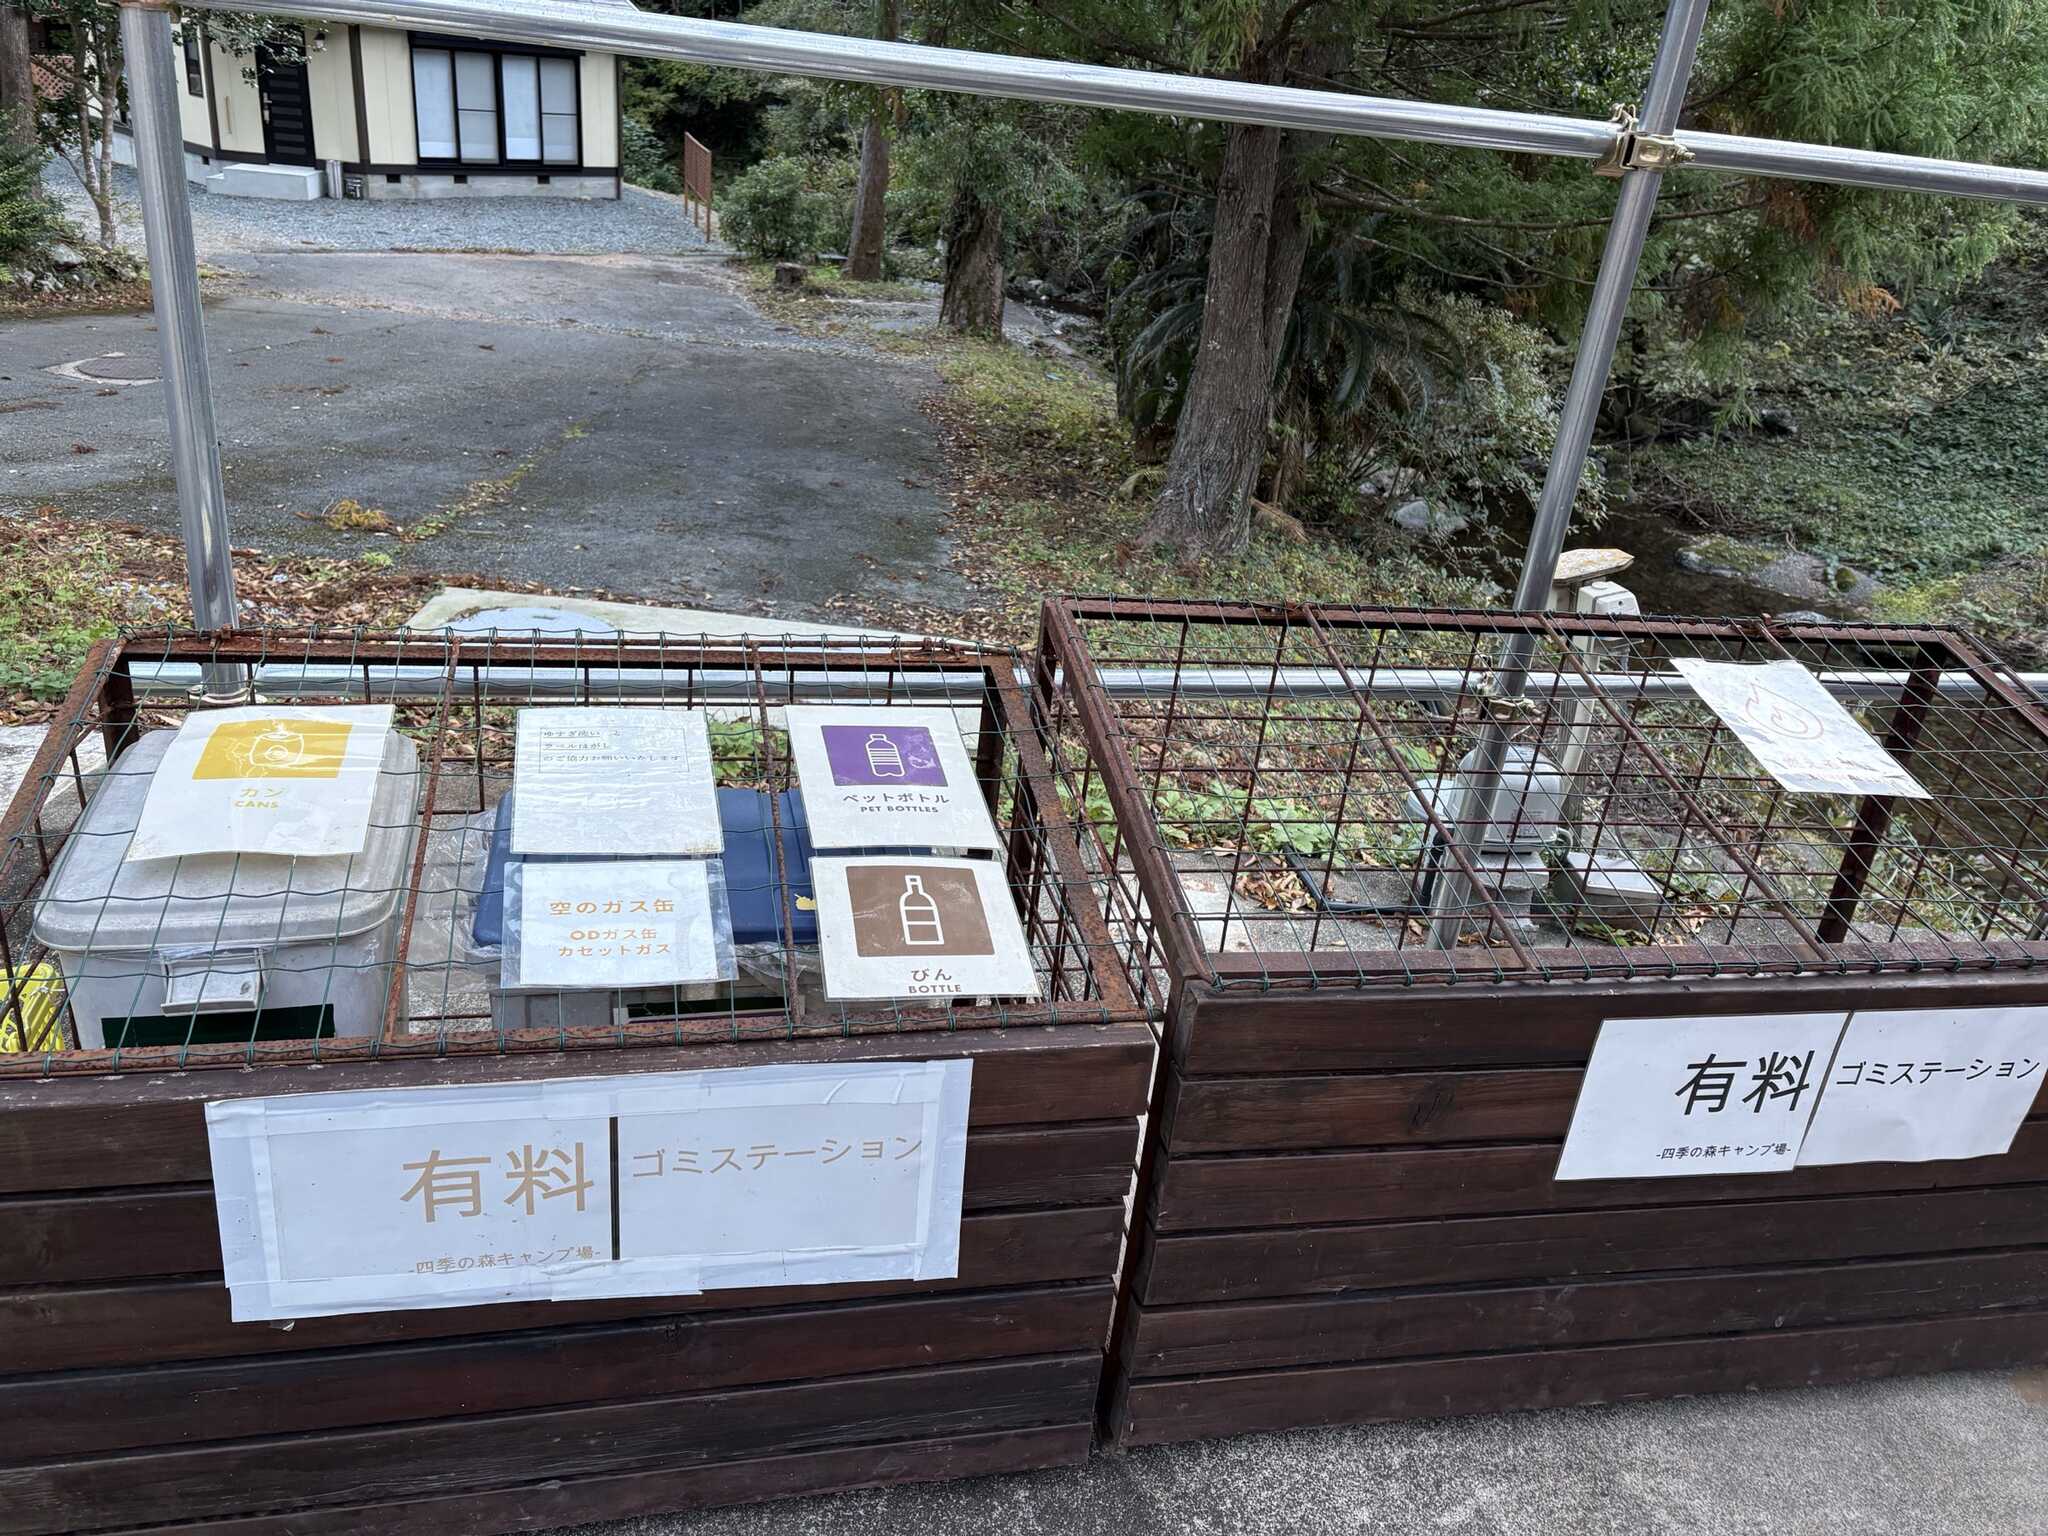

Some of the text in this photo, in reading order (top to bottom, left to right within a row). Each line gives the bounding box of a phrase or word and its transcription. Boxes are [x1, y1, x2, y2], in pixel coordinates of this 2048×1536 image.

[239, 786, 284, 798] カン
[843, 792, 949, 803] ペットボトル
[234, 800, 279, 809] CANS
[860, 805, 939, 813] PET BOTTLES
[549, 898, 675, 916] 空のガス缶
[570, 928, 657, 941] ODガス缶
[559, 943, 671, 957] カセットガス
[911, 968, 952, 982] びん
[908, 984, 962, 994] BOTTLE
[1674, 1049, 2041, 1117] 有料 ゴミステーション
[400, 1134, 924, 1223] 有料 ゴミステーション
